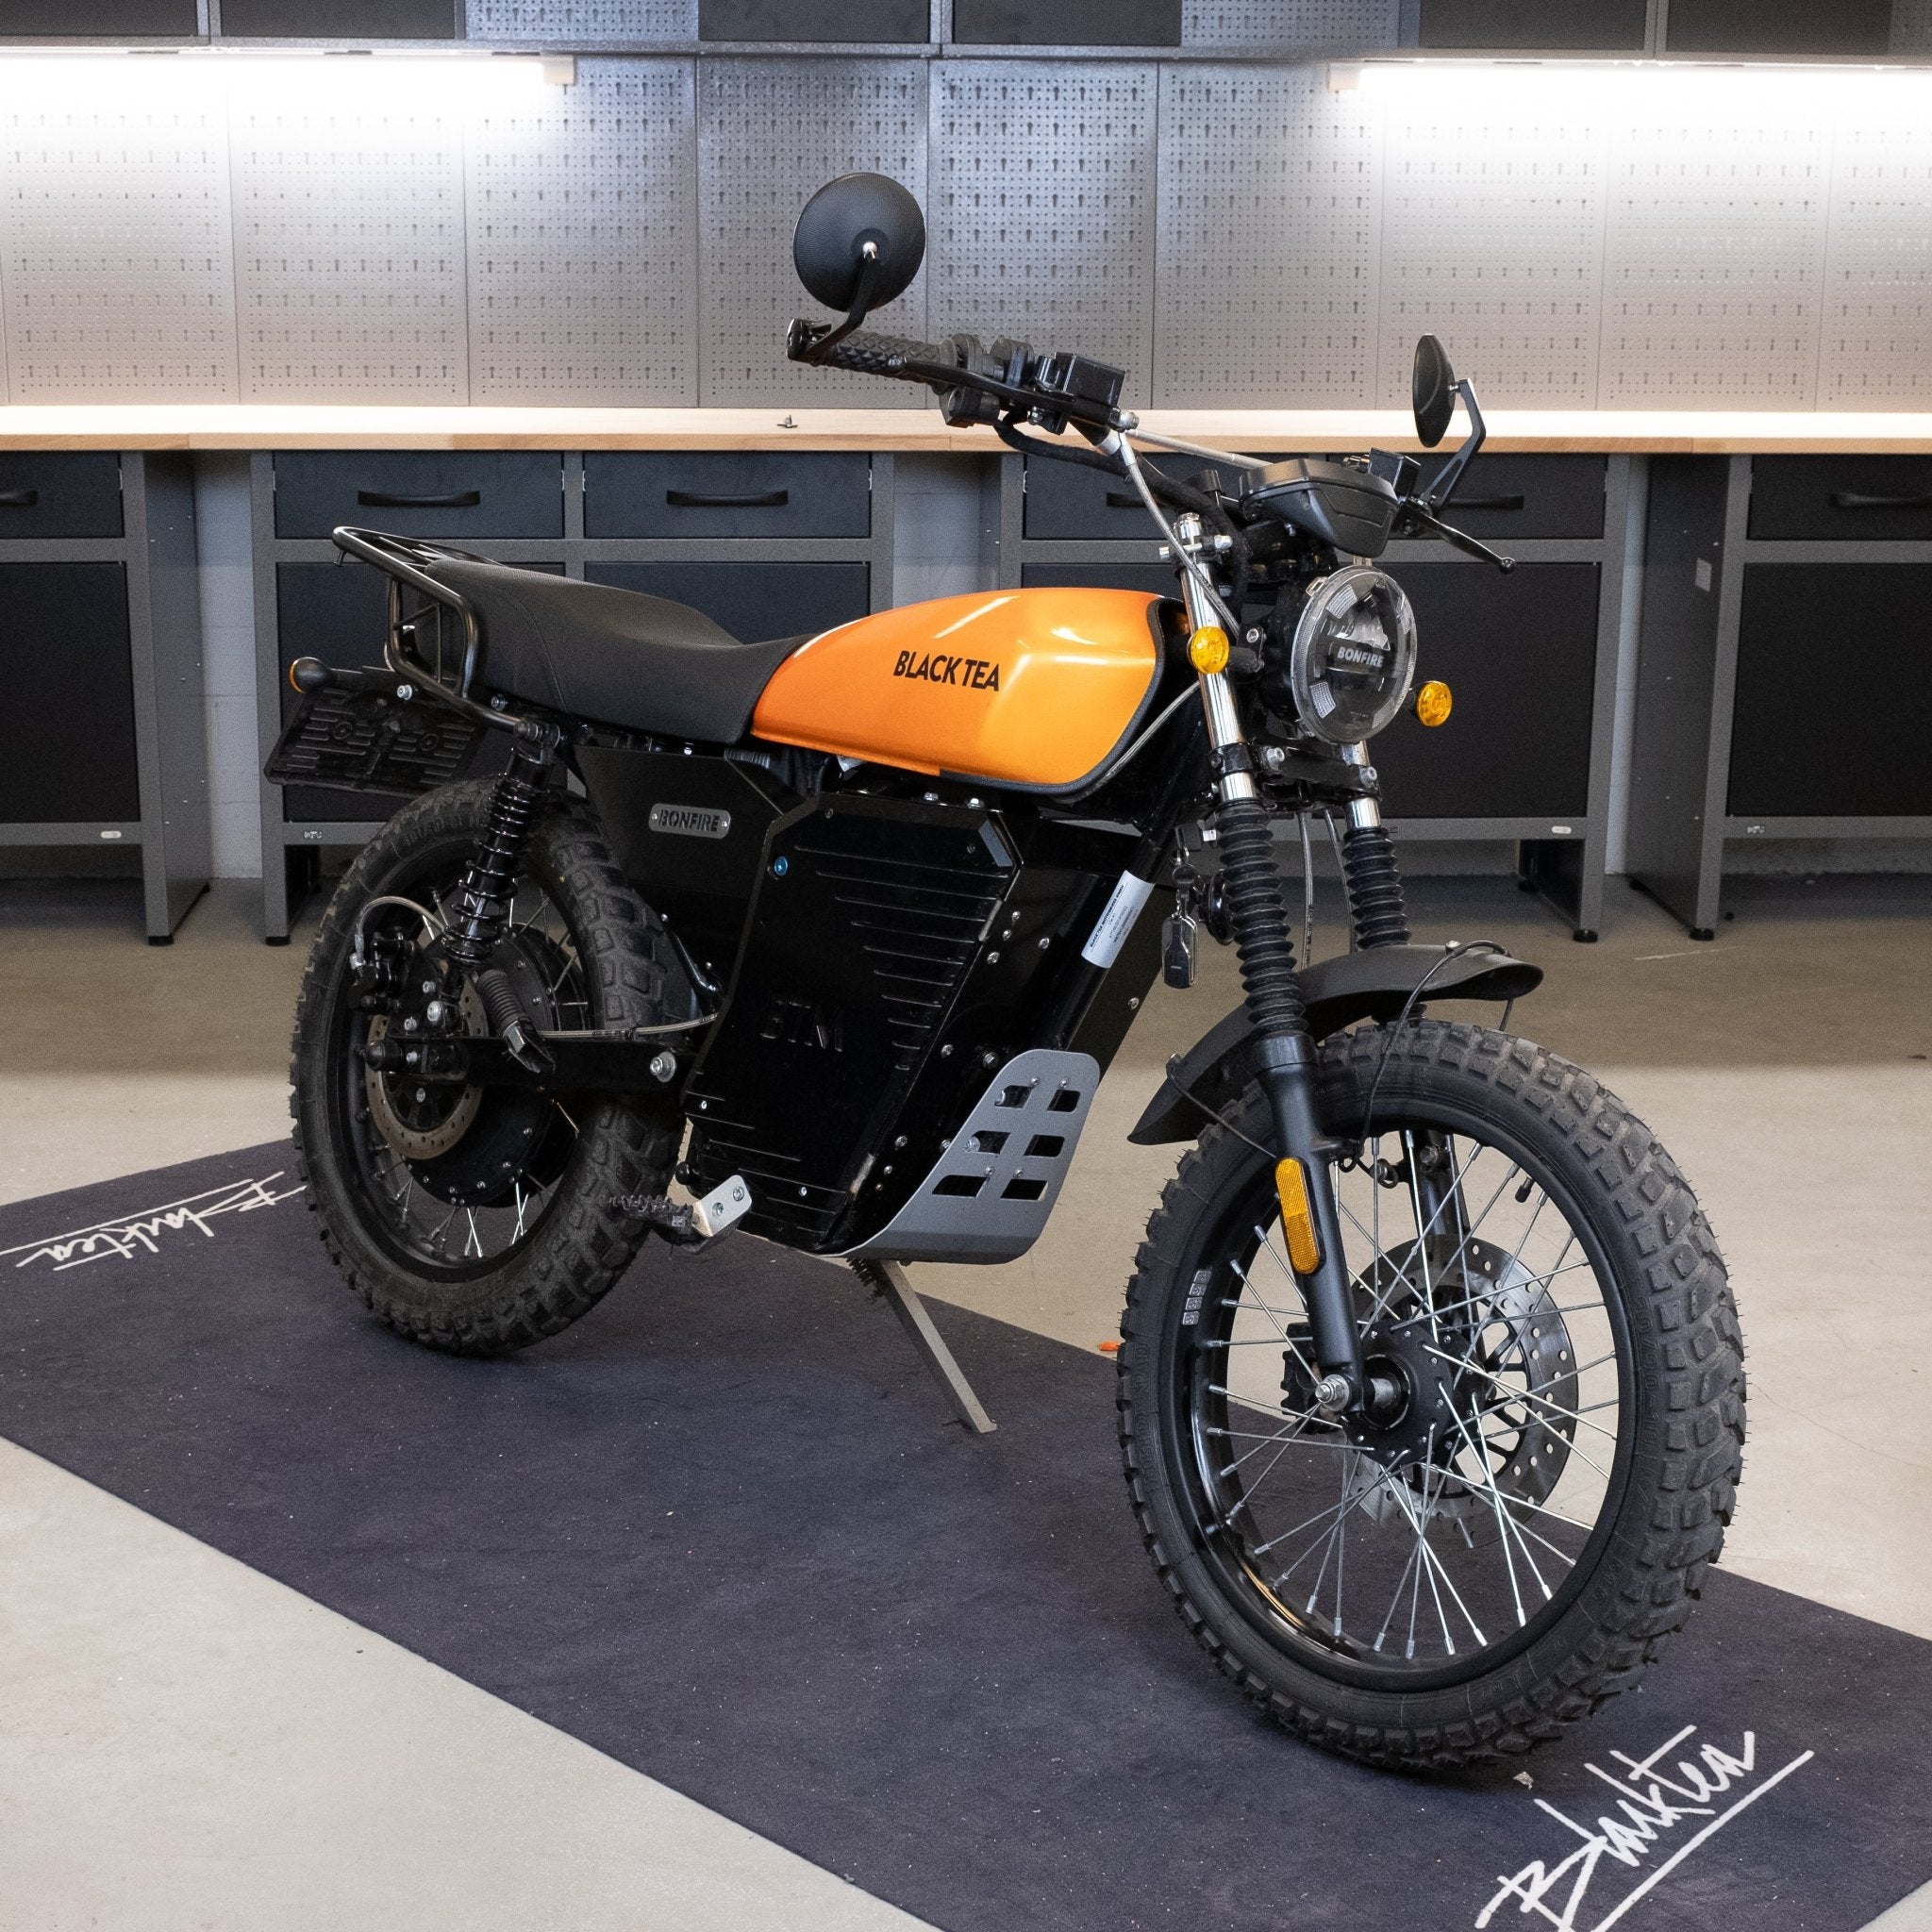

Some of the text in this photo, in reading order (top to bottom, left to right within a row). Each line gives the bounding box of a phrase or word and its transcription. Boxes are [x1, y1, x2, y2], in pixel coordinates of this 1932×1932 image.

[1337, 646, 1384, 668] BONFIRE
[892, 650, 999, 691] BLACK TEA
[658, 809, 720, 832] BONFIRE
